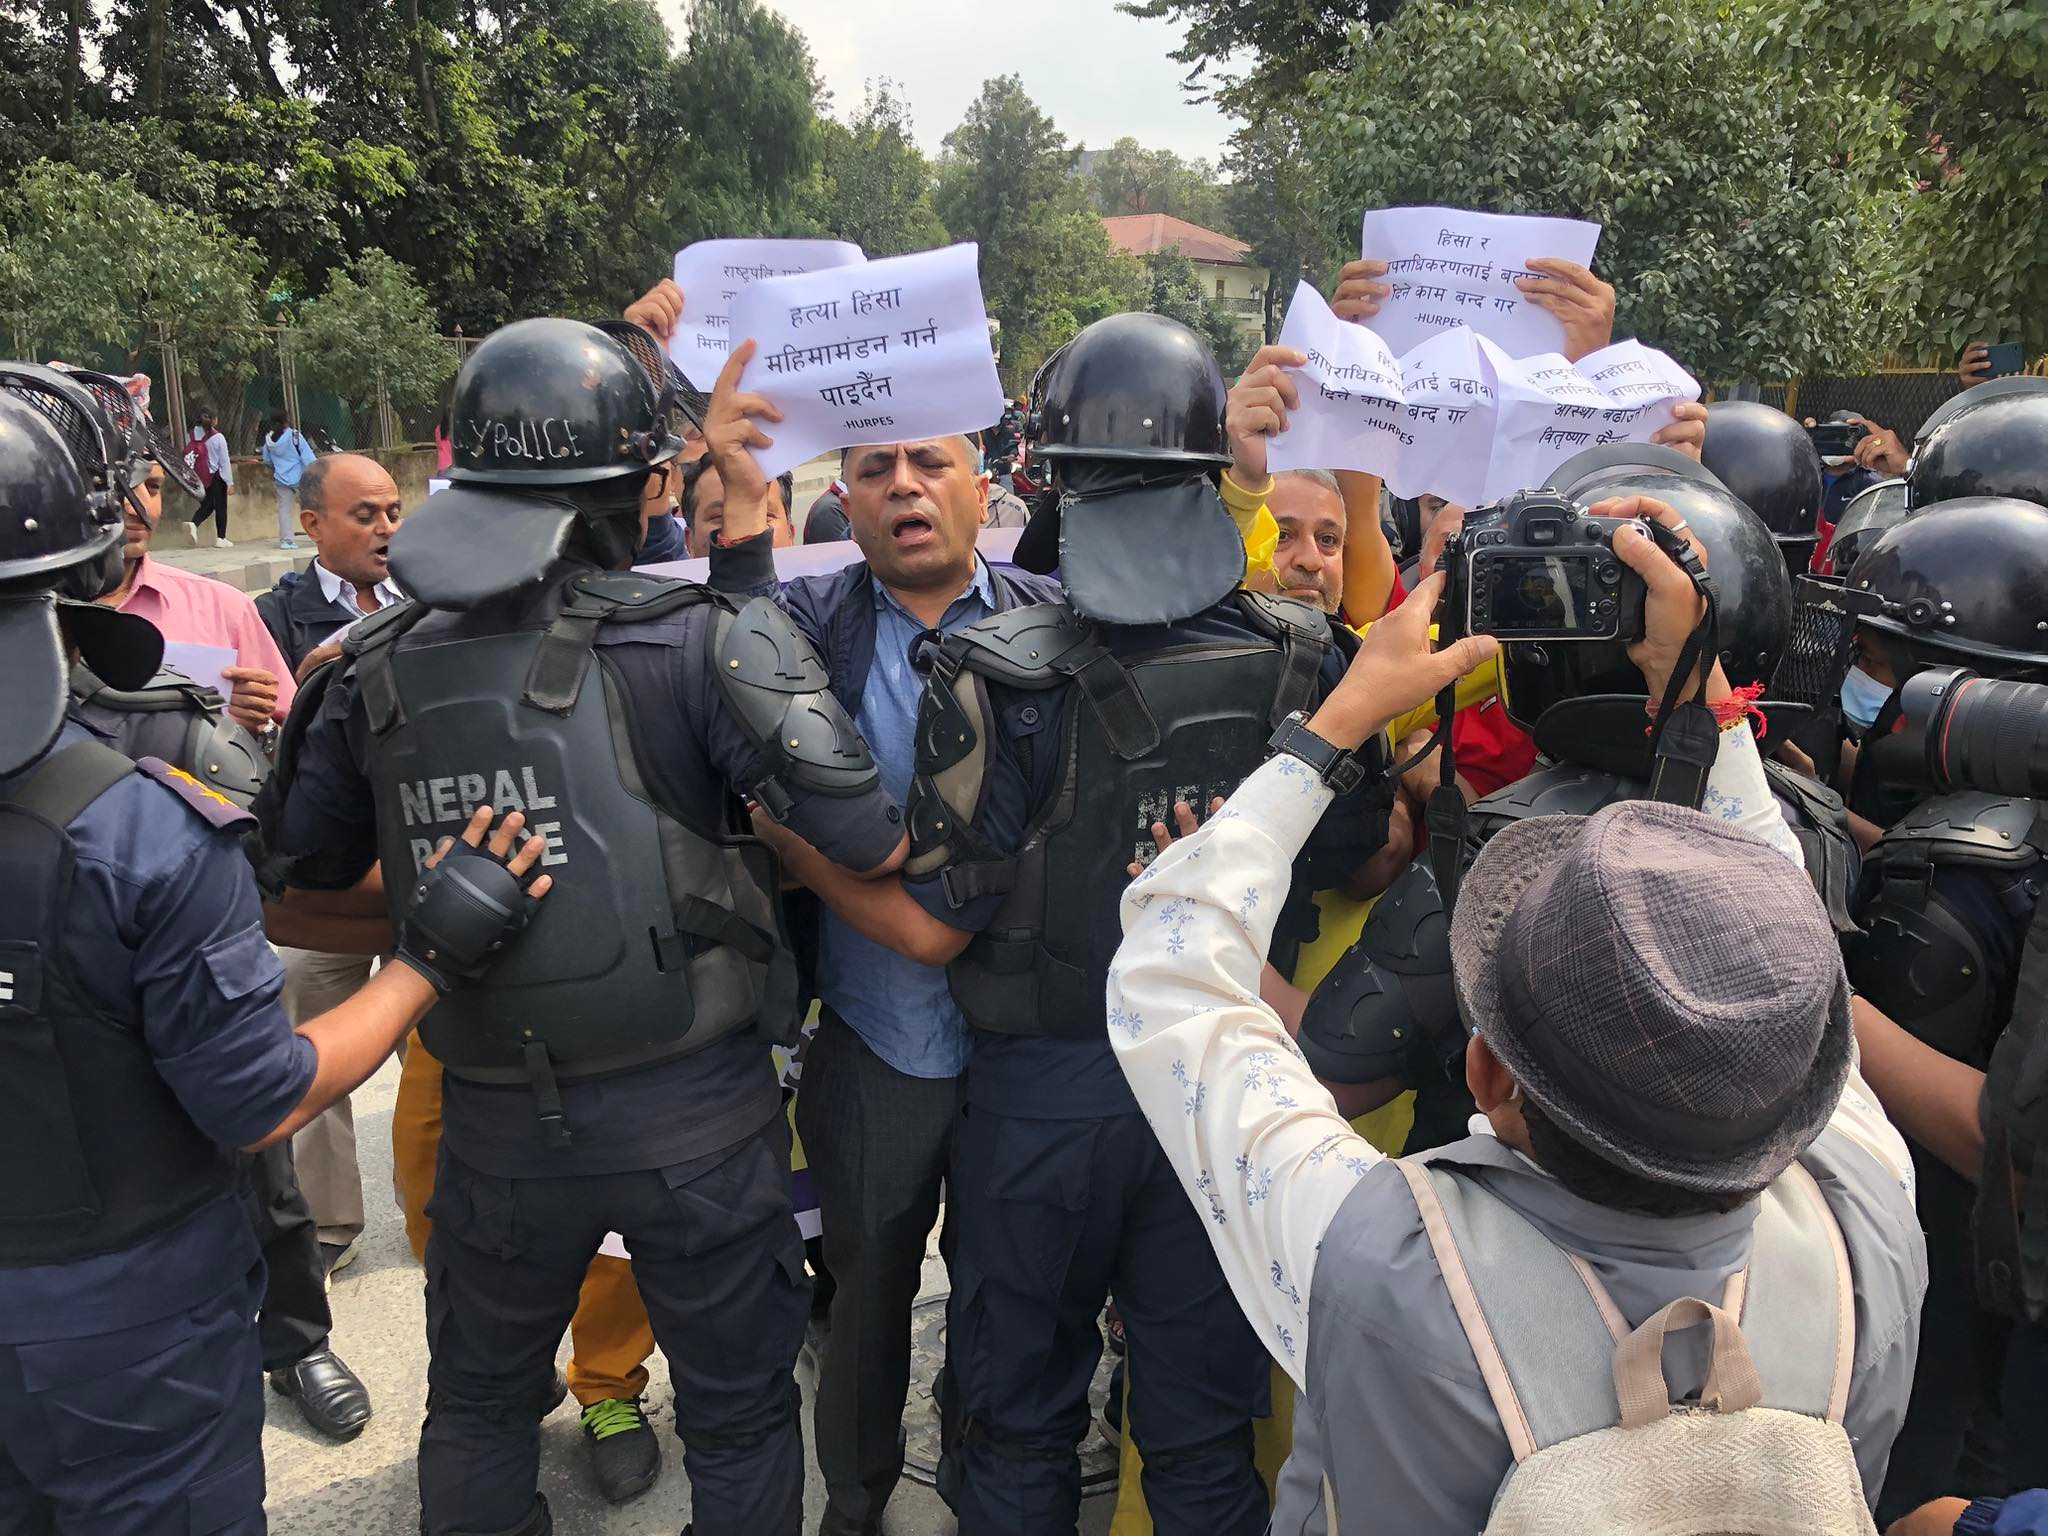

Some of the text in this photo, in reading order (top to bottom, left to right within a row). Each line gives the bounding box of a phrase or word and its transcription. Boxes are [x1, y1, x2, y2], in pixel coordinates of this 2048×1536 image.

[1437, 228, 1491, 251] हिंसा र
[1386, 253, 1494, 282] पराधिकरणलाई
[789, 287, 902, 329] हत्या हिंसा
[1414, 285, 1449, 301] काम
[1455, 290, 1487, 309] बन्द
[1493, 297, 1518, 315] गर
[764, 317, 939, 374] महिमामंडन गर्न
[842, 416, 895, 430] -HURPES
[1407, 403, 1440, 424] बन्द
[1554, 402, 1600, 420] आस्था
[399, 766, 558, 826] NEPAL
